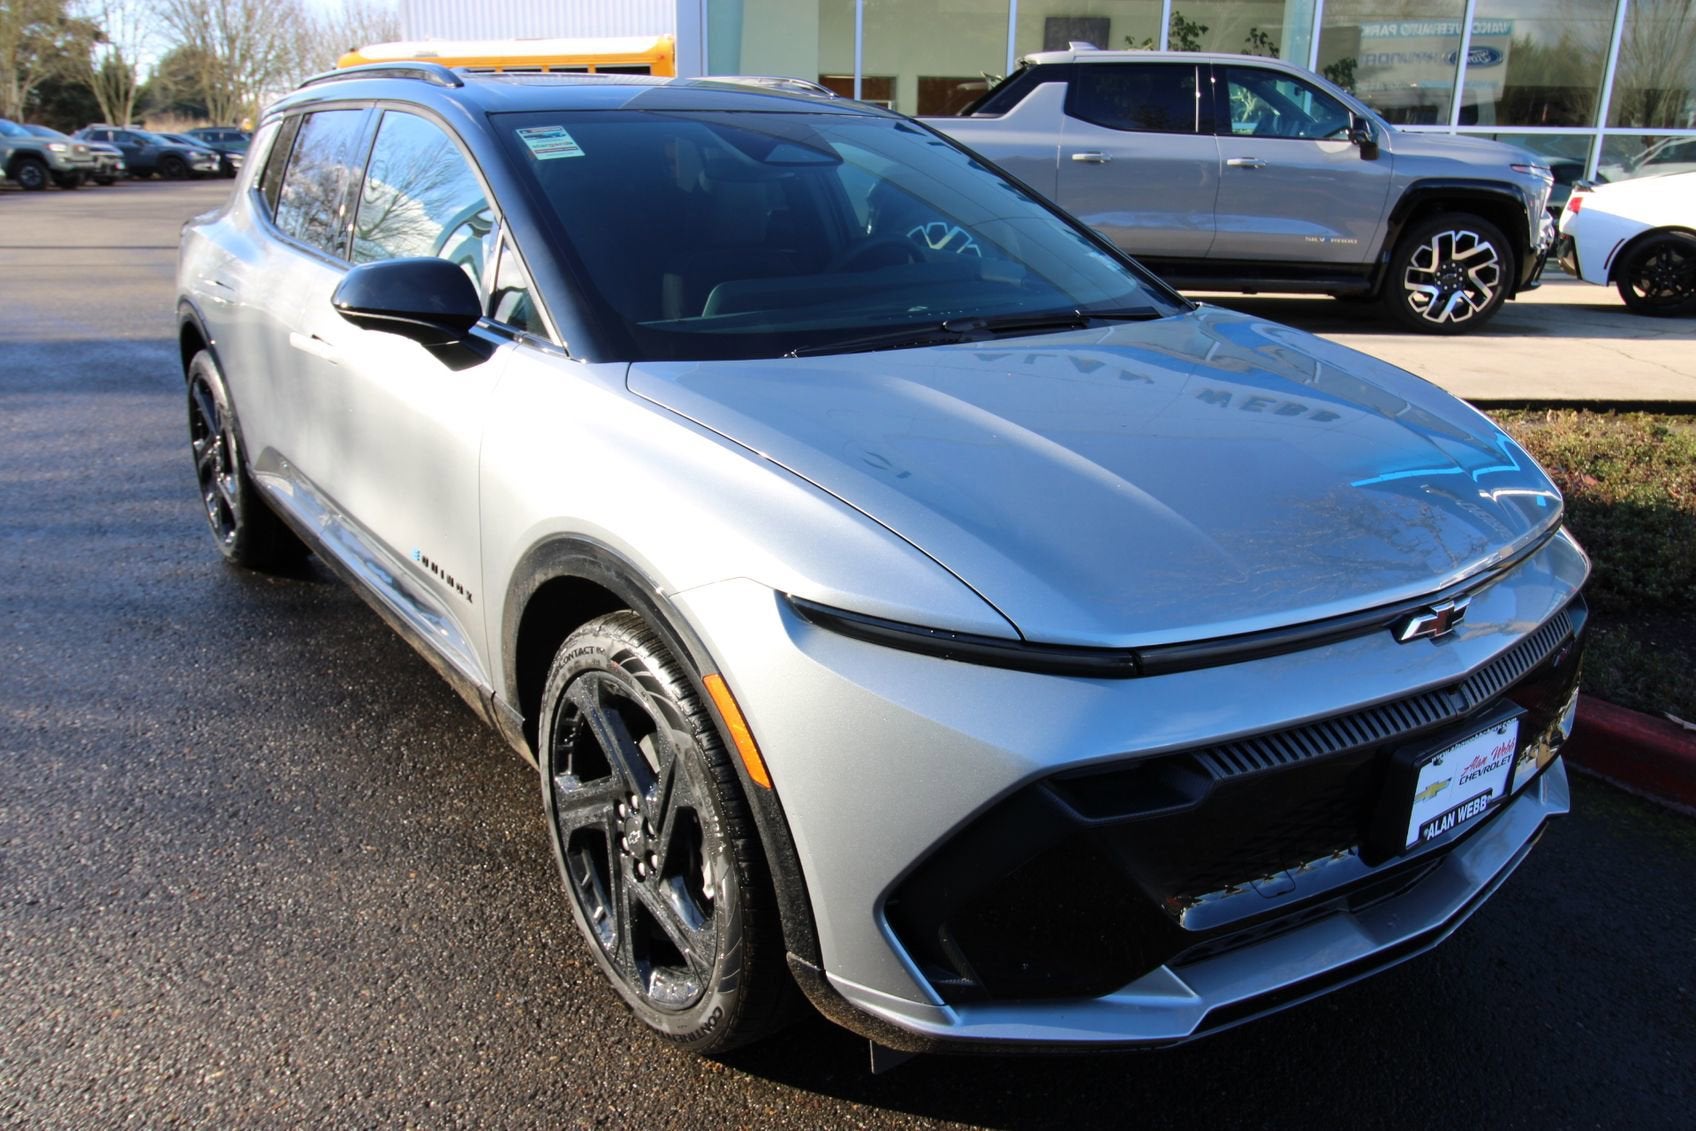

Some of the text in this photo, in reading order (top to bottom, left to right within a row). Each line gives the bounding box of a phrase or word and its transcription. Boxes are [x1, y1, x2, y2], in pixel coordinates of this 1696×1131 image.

[1459, 754, 1512, 785] CHEVROLET
[1461, 754, 1488, 777] Alan
[1427, 794, 1488, 841] ALAN WEBB
